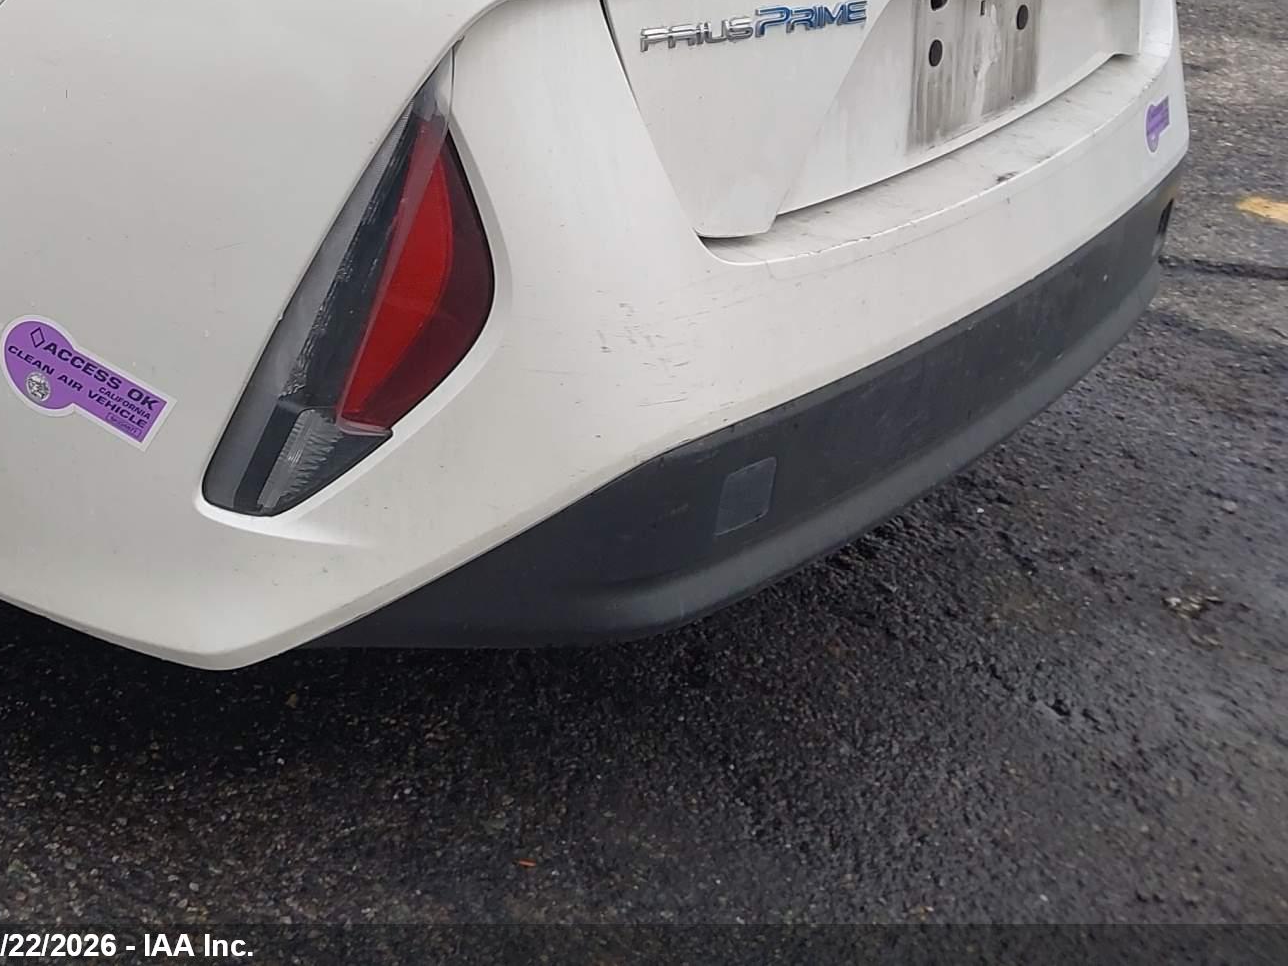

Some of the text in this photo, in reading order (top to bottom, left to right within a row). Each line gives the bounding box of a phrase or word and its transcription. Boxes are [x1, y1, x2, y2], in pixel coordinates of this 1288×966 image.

[640, 0, 868, 52] PRIUS PRIME
[8, 345, 55, 375] CLEAN
[57, 374, 83, 392] AIR
[87, 389, 148, 429] VEHICLE
[43, 342, 160, 411] ACCESS OK
[98, 387, 152, 420] CALIFORNIA
